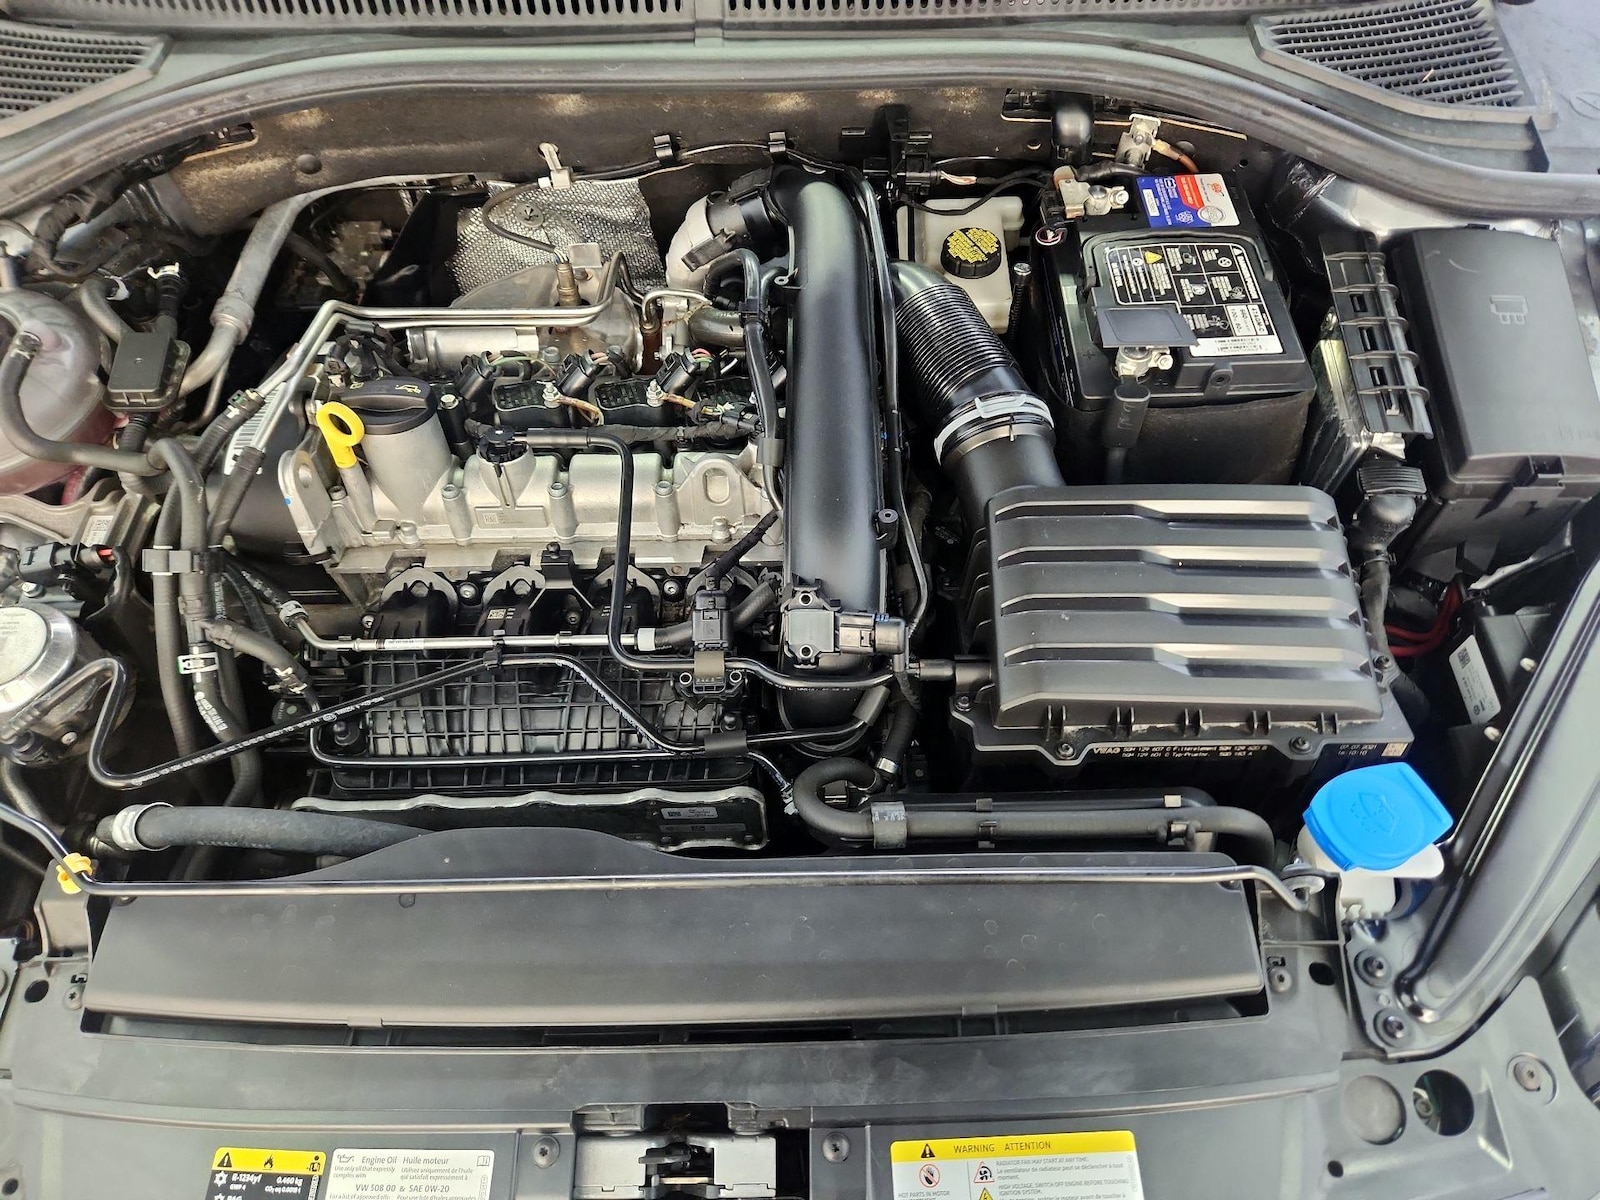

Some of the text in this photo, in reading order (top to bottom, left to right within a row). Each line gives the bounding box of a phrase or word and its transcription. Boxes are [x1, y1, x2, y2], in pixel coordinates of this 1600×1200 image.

[953, 1141, 1051, 1153] WARNING ATTENTION
[361, 1156, 386, 1165] Engine
